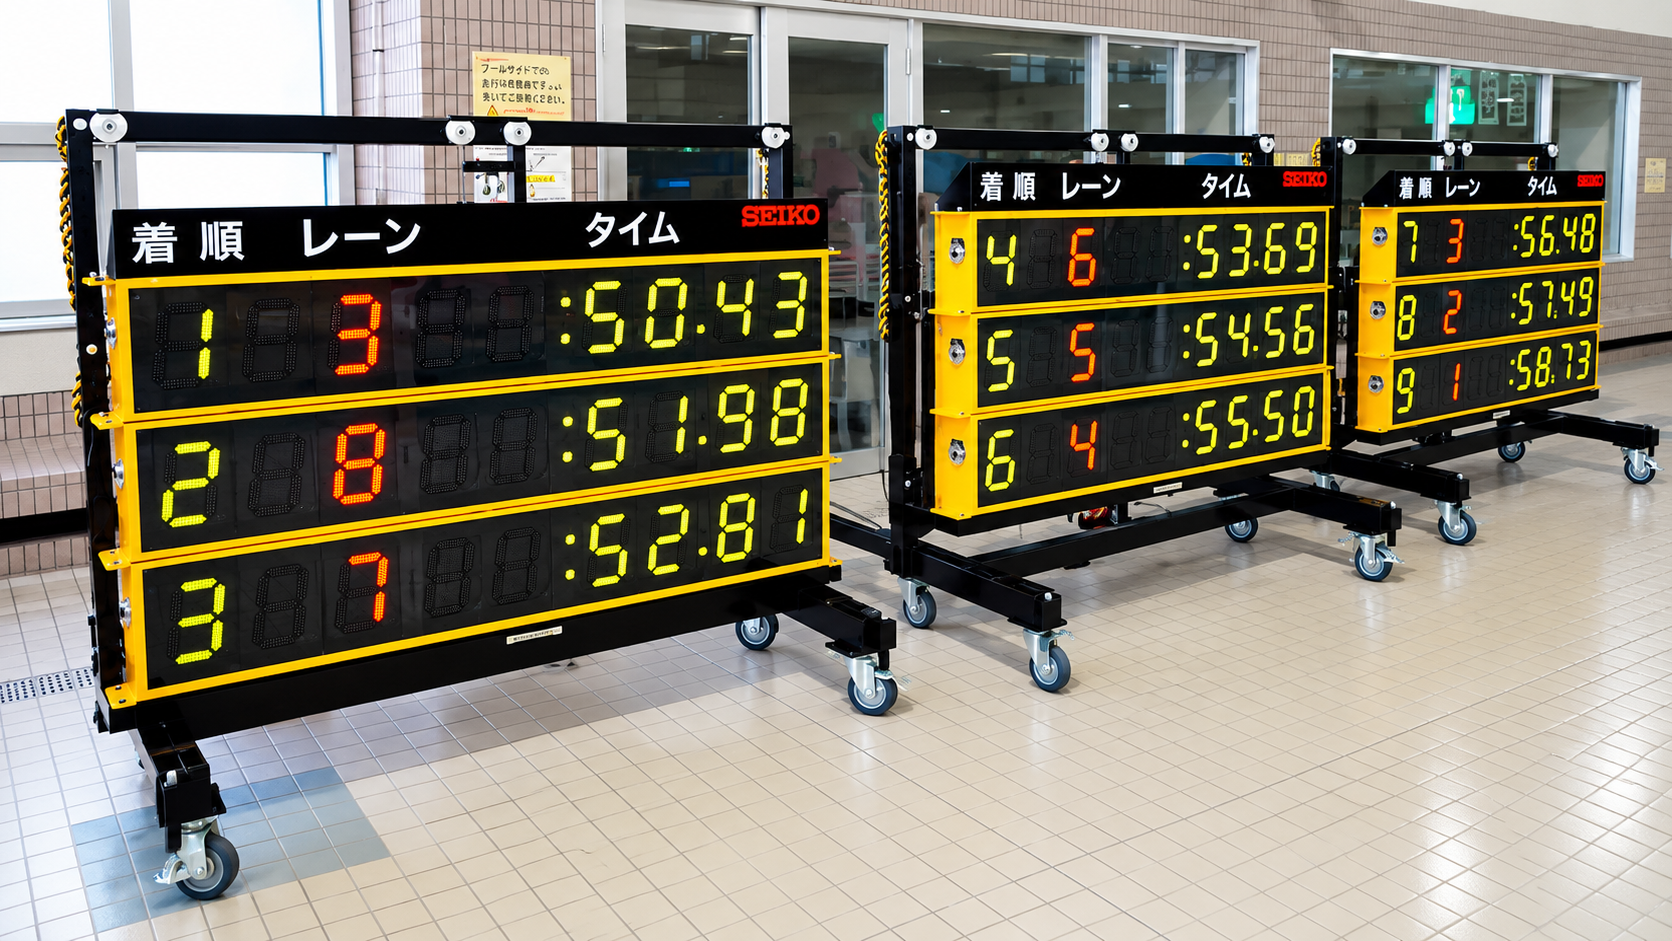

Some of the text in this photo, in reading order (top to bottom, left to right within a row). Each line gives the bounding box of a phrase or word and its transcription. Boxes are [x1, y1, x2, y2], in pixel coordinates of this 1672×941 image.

[1063, 173, 1120, 199] レーン
[1202, 173, 1251, 199] タイム
[1283, 171, 1327, 187] SEIKO
[1446, 177, 1480, 197] レーン
[1528, 176, 1557, 196] タイム
[304, 219, 420, 257] レーン
[586, 211, 679, 247] タイム
[742, 205, 820, 227] SEIKO
[1404, 221, 1418, 262] 7
[1447, 219, 1464, 263] 3
[987, 235, 1016, 285] 4
[1068, 228, 1096, 287] 6
[199, 309, 213, 379] 1
[335, 294, 382, 375] 3
[1397, 295, 1416, 340] 8
[1443, 290, 1462, 334] 2
[987, 330, 1014, 392] 5
[1070, 323, 1096, 382] 5
[1397, 368, 1415, 414] 9
[1453, 363, 1460, 400] 1
[162, 441, 220, 527] 2
[333, 423, 386, 505] 8
[985, 429, 1015, 491] 6
[1070, 421, 1097, 470] 4
[176, 578, 225, 664] 3
[348, 552, 389, 622] 7
